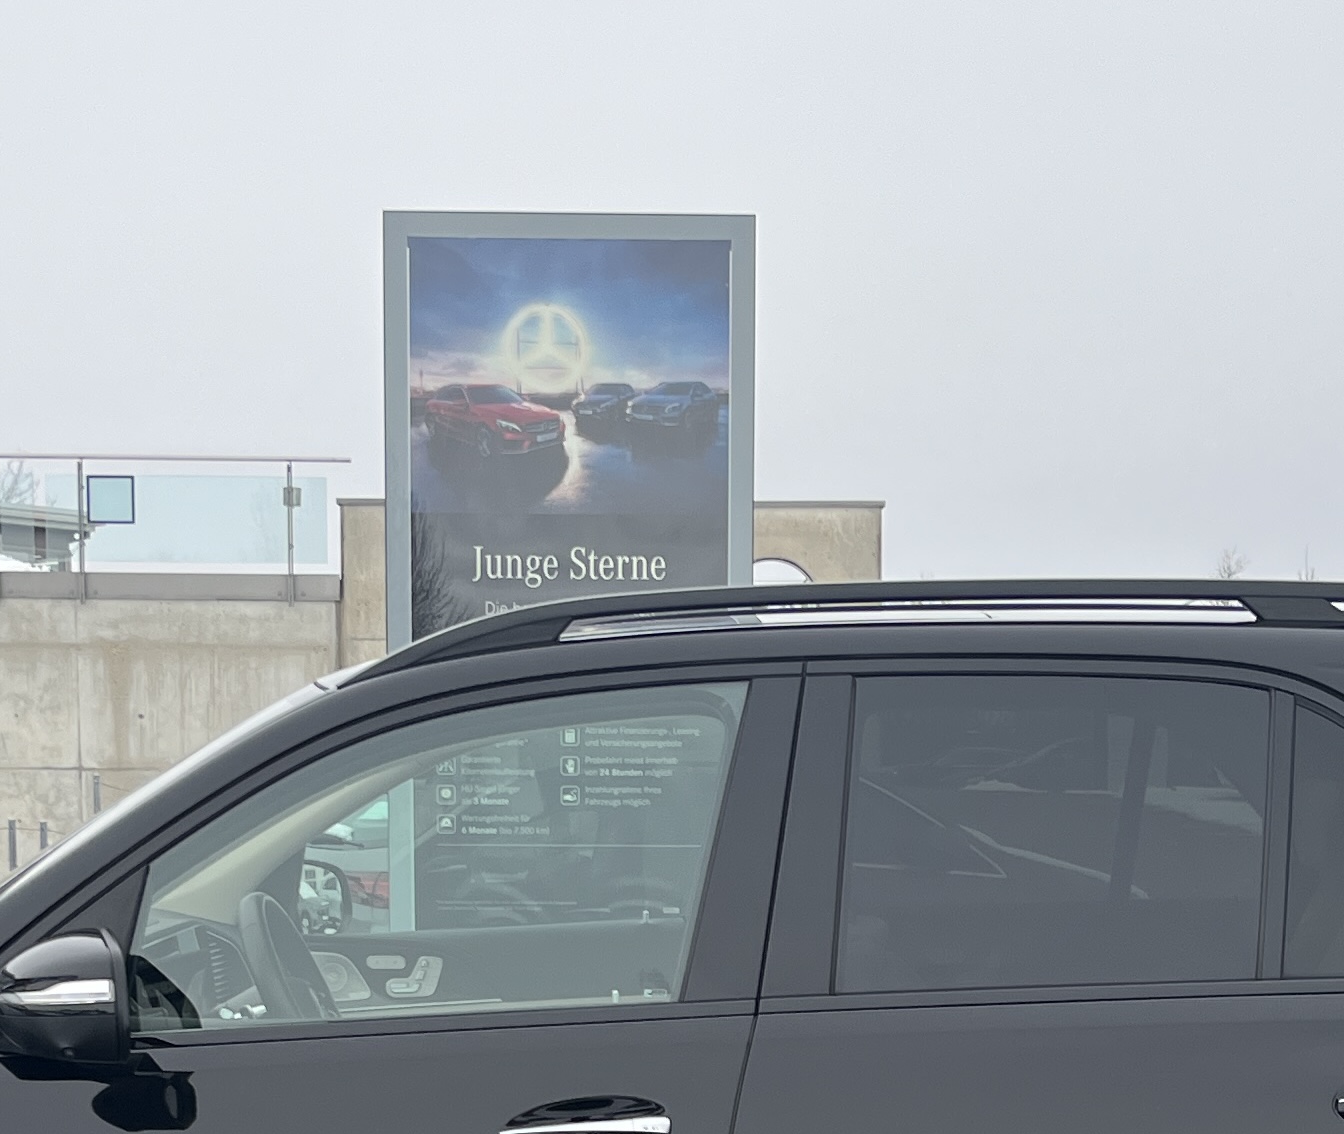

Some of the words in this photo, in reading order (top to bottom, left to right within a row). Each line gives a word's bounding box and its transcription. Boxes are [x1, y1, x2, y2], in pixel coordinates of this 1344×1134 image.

[472, 545, 559, 589] Junge
[570, 546, 667, 581] Sterne
[599, 768, 610, 776] 24
[611, 768, 644, 776] Stunden
[480, 797, 510, 805] Monate
[468, 825, 498, 835] Monate
